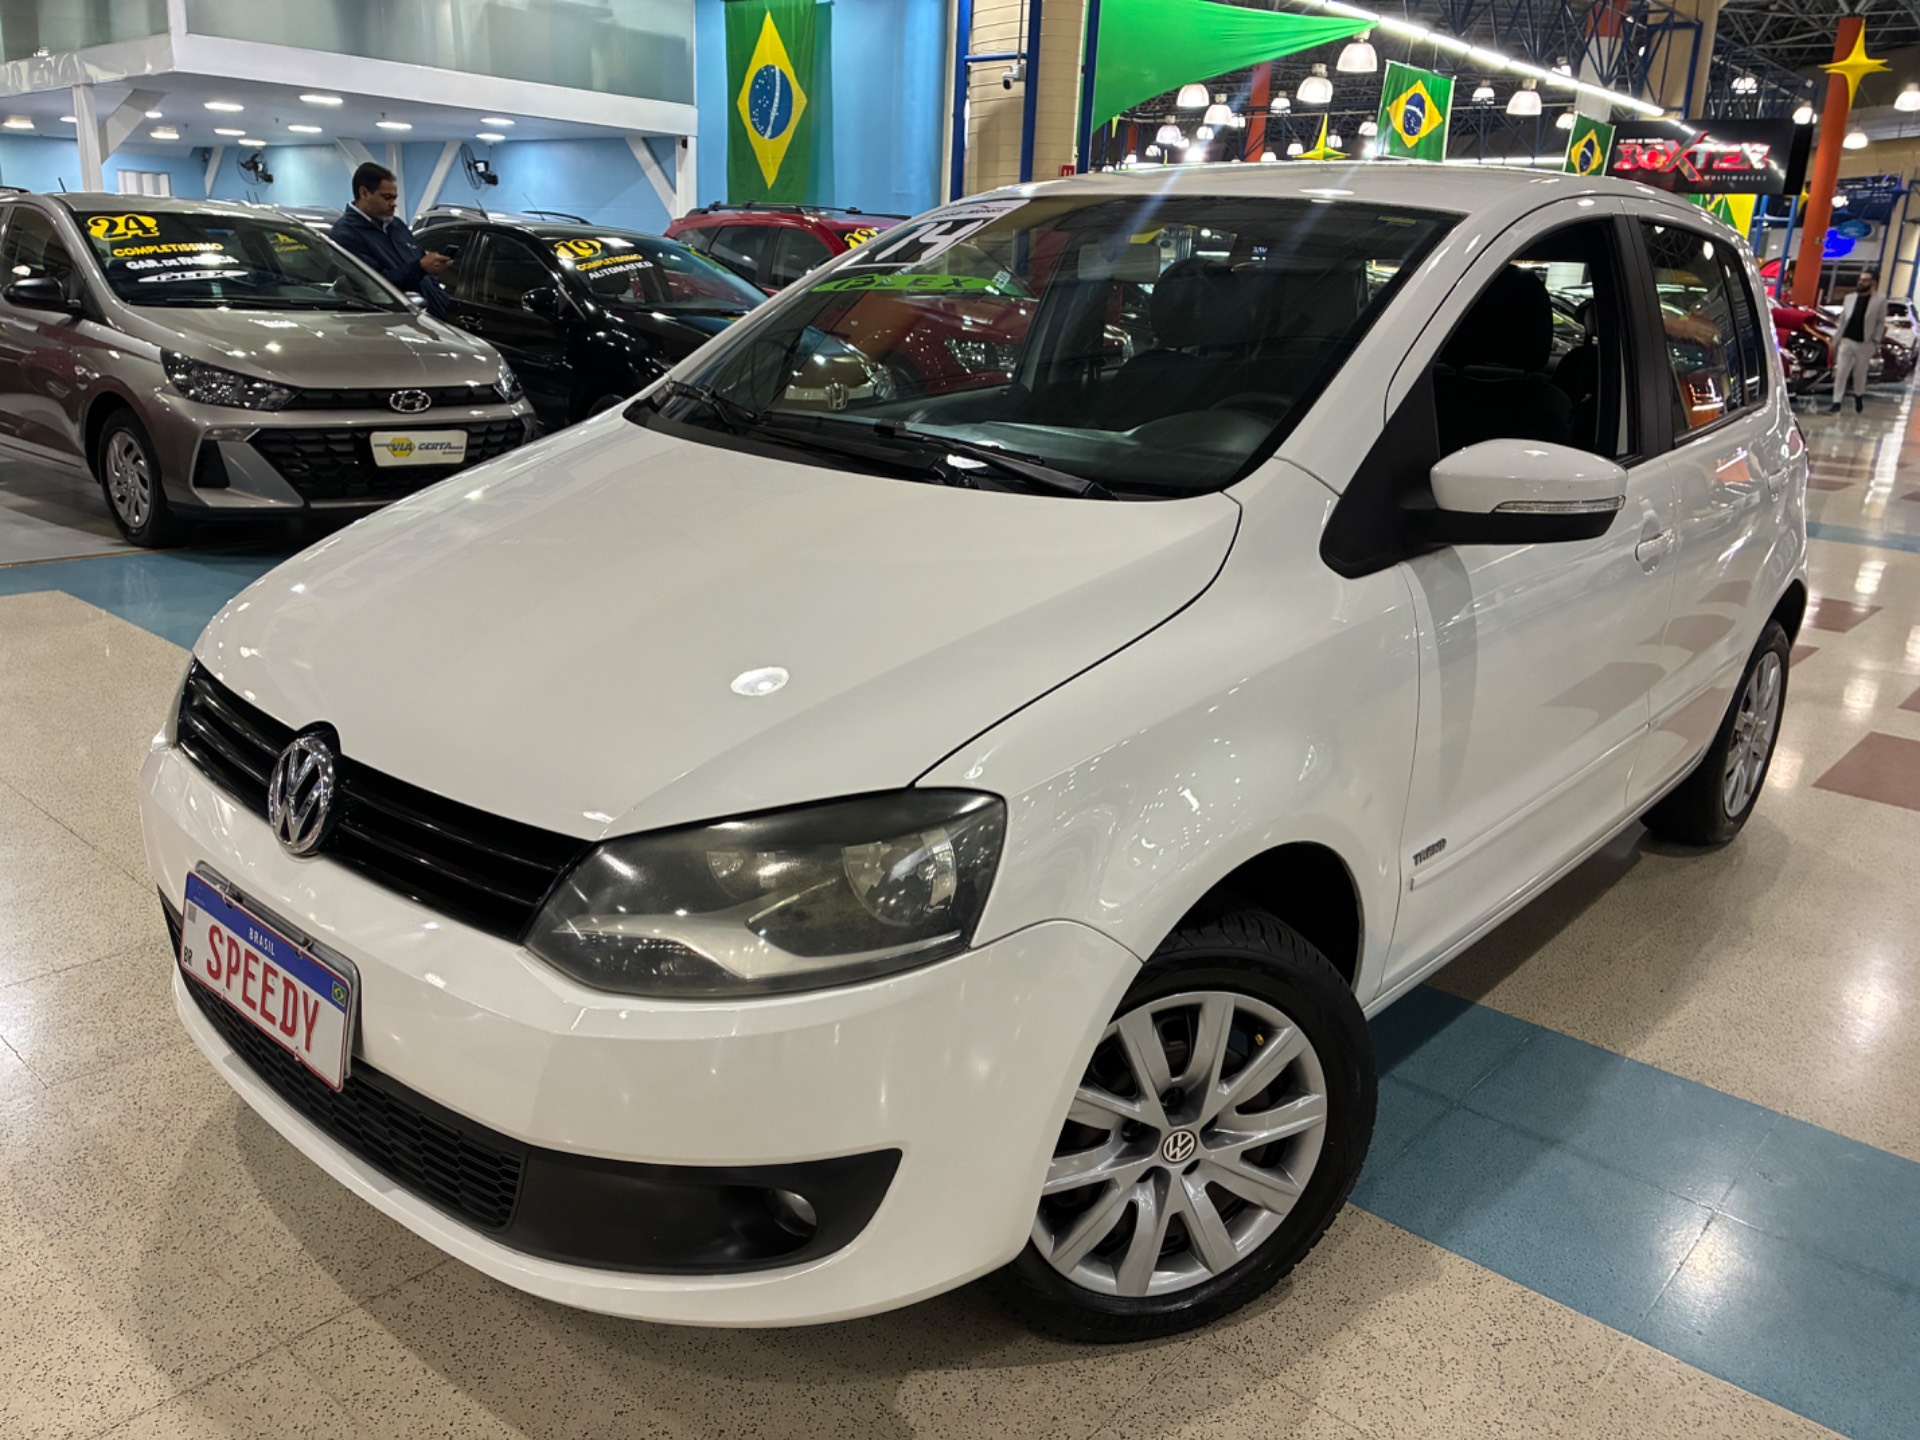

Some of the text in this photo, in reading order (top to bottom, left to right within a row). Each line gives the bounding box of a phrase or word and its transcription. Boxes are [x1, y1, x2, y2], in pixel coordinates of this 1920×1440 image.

[88, 214, 158, 240] 24
[554, 239, 601, 259] 19
[391, 441, 452, 451] VIA CERTA
[248, 926, 276, 957] BRASIL
[183, 945, 194, 967] BR
[206, 924, 320, 1053] SPEEDY
